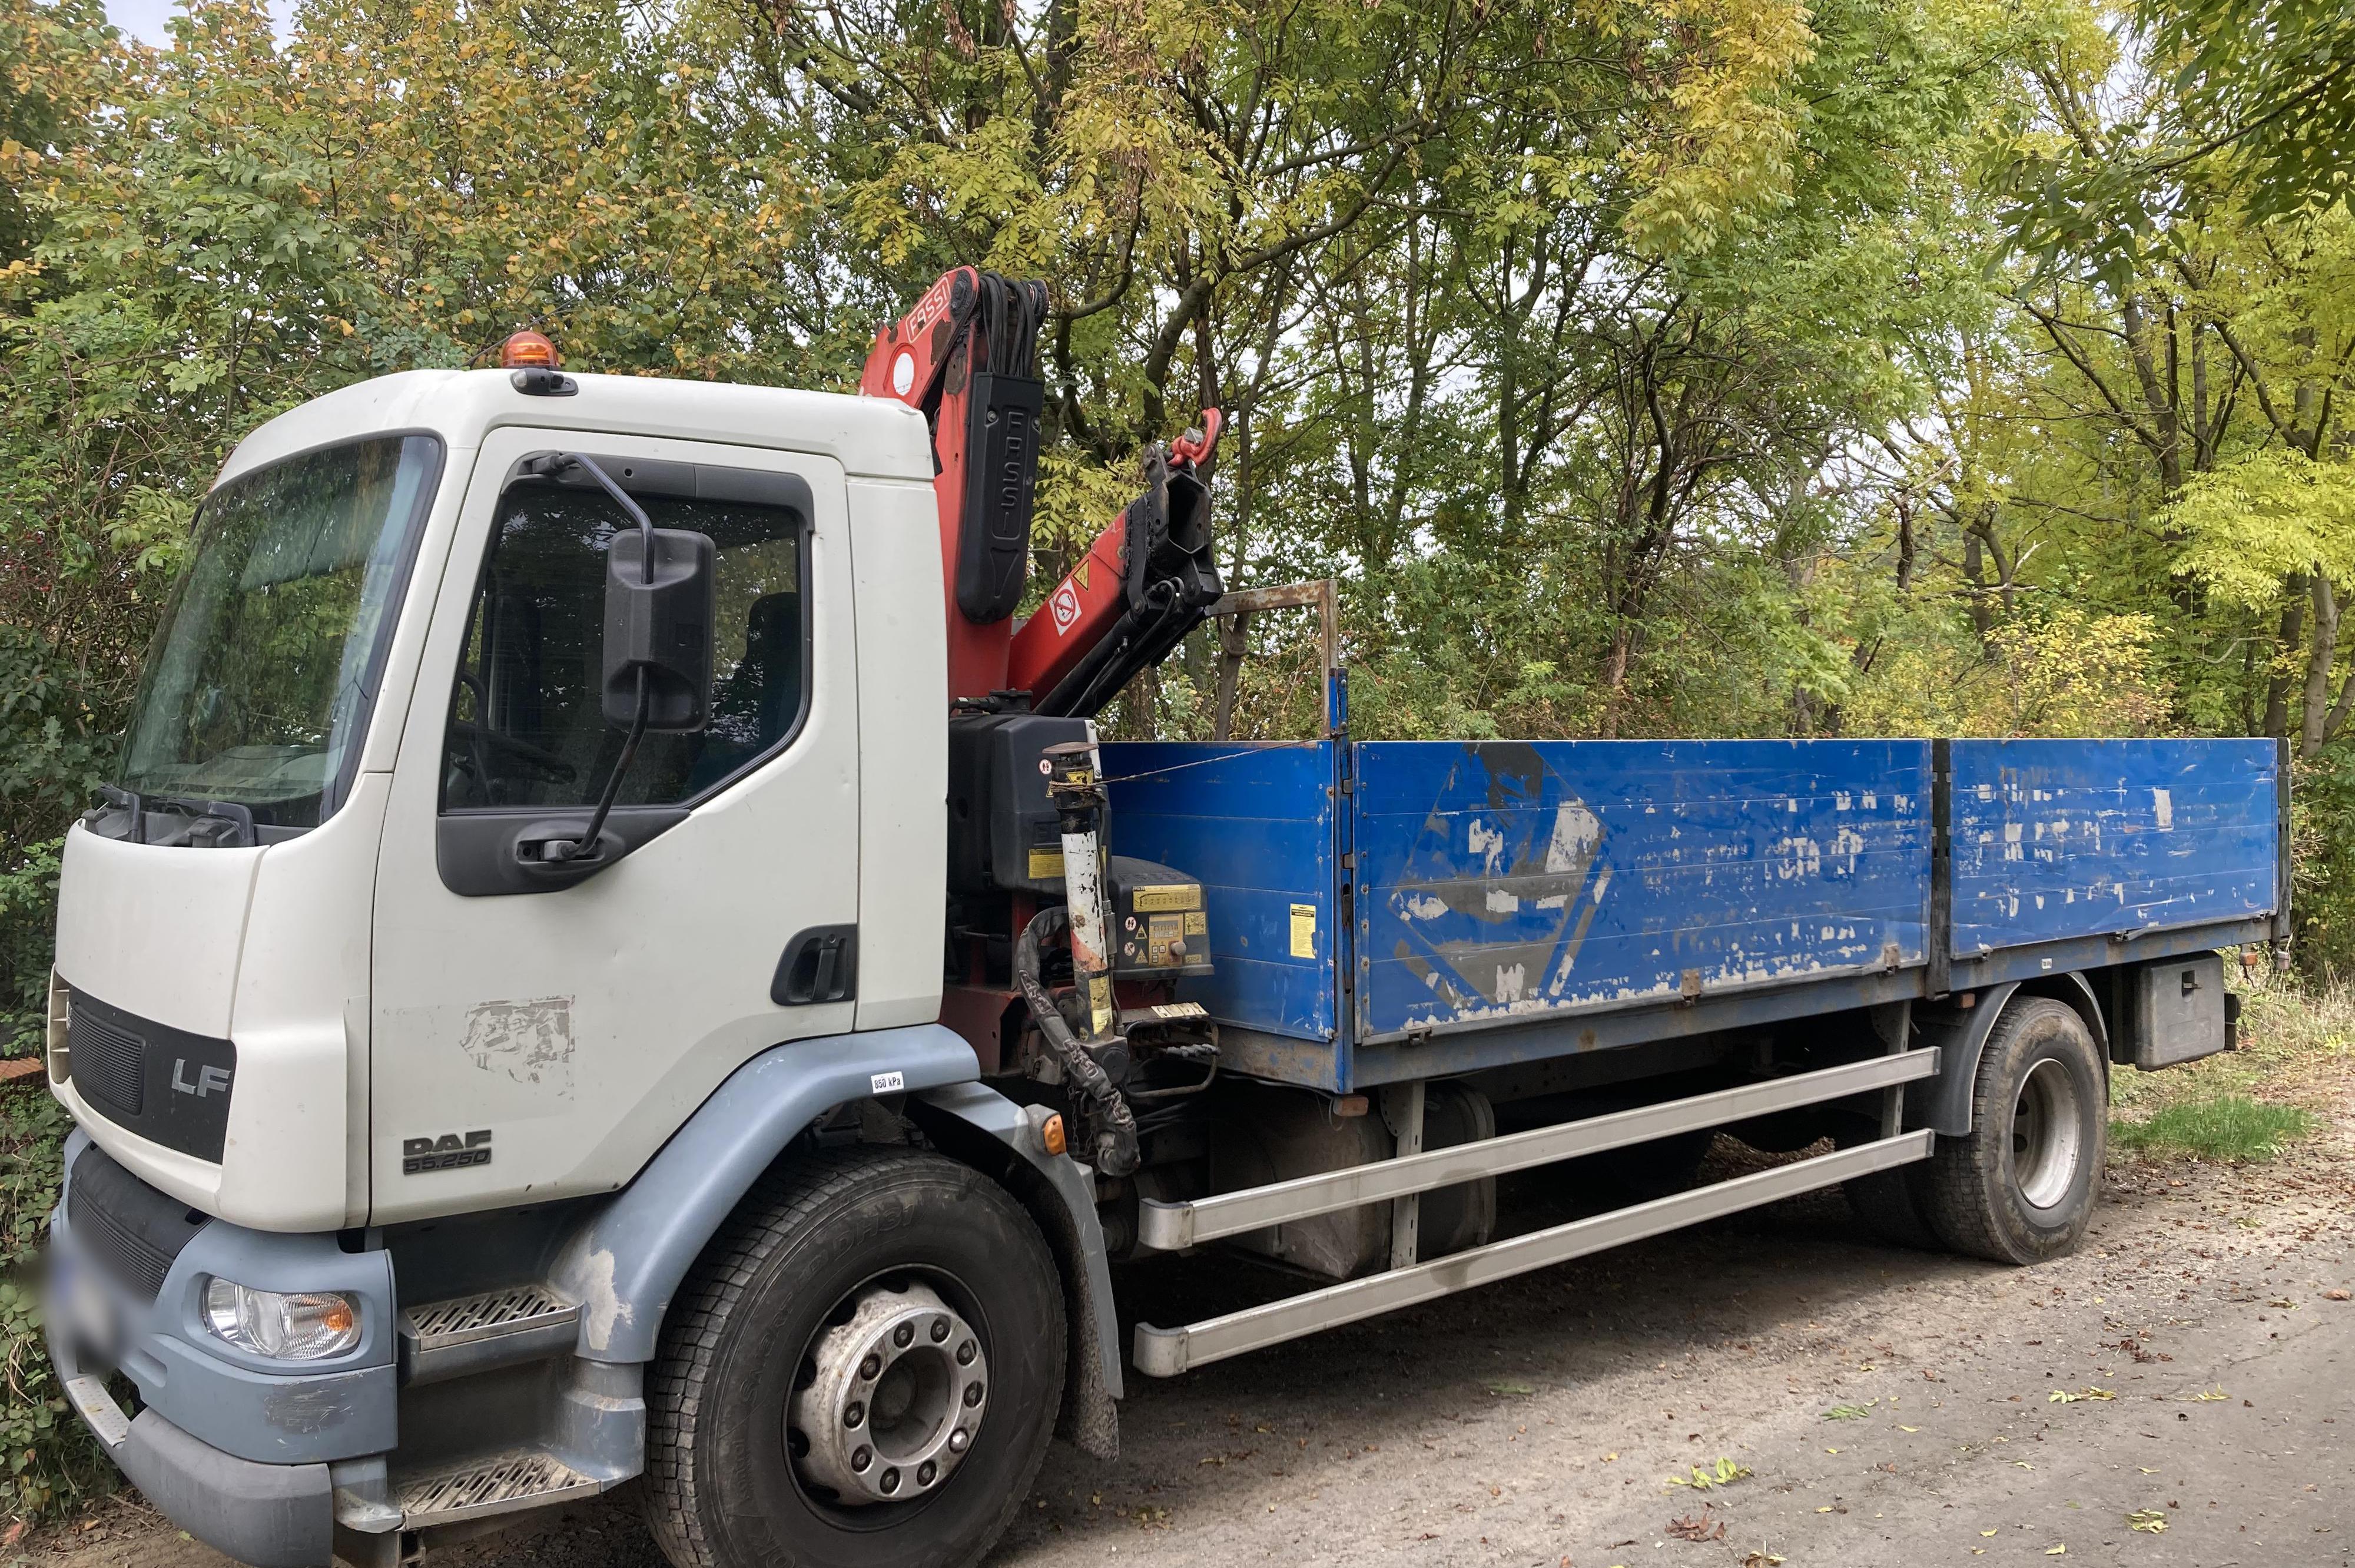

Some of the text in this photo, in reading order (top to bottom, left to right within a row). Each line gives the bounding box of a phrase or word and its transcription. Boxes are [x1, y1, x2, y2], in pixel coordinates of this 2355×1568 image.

[910, 285, 947, 336] FASSI
[1001, 411, 1024, 533] FASSI
[171, 1058, 231, 1098] LF
[874, 1076, 901, 1089] 850 kPa
[403, 1129, 491, 1156] DAF
[404, 1149, 490, 1172] 55.250
